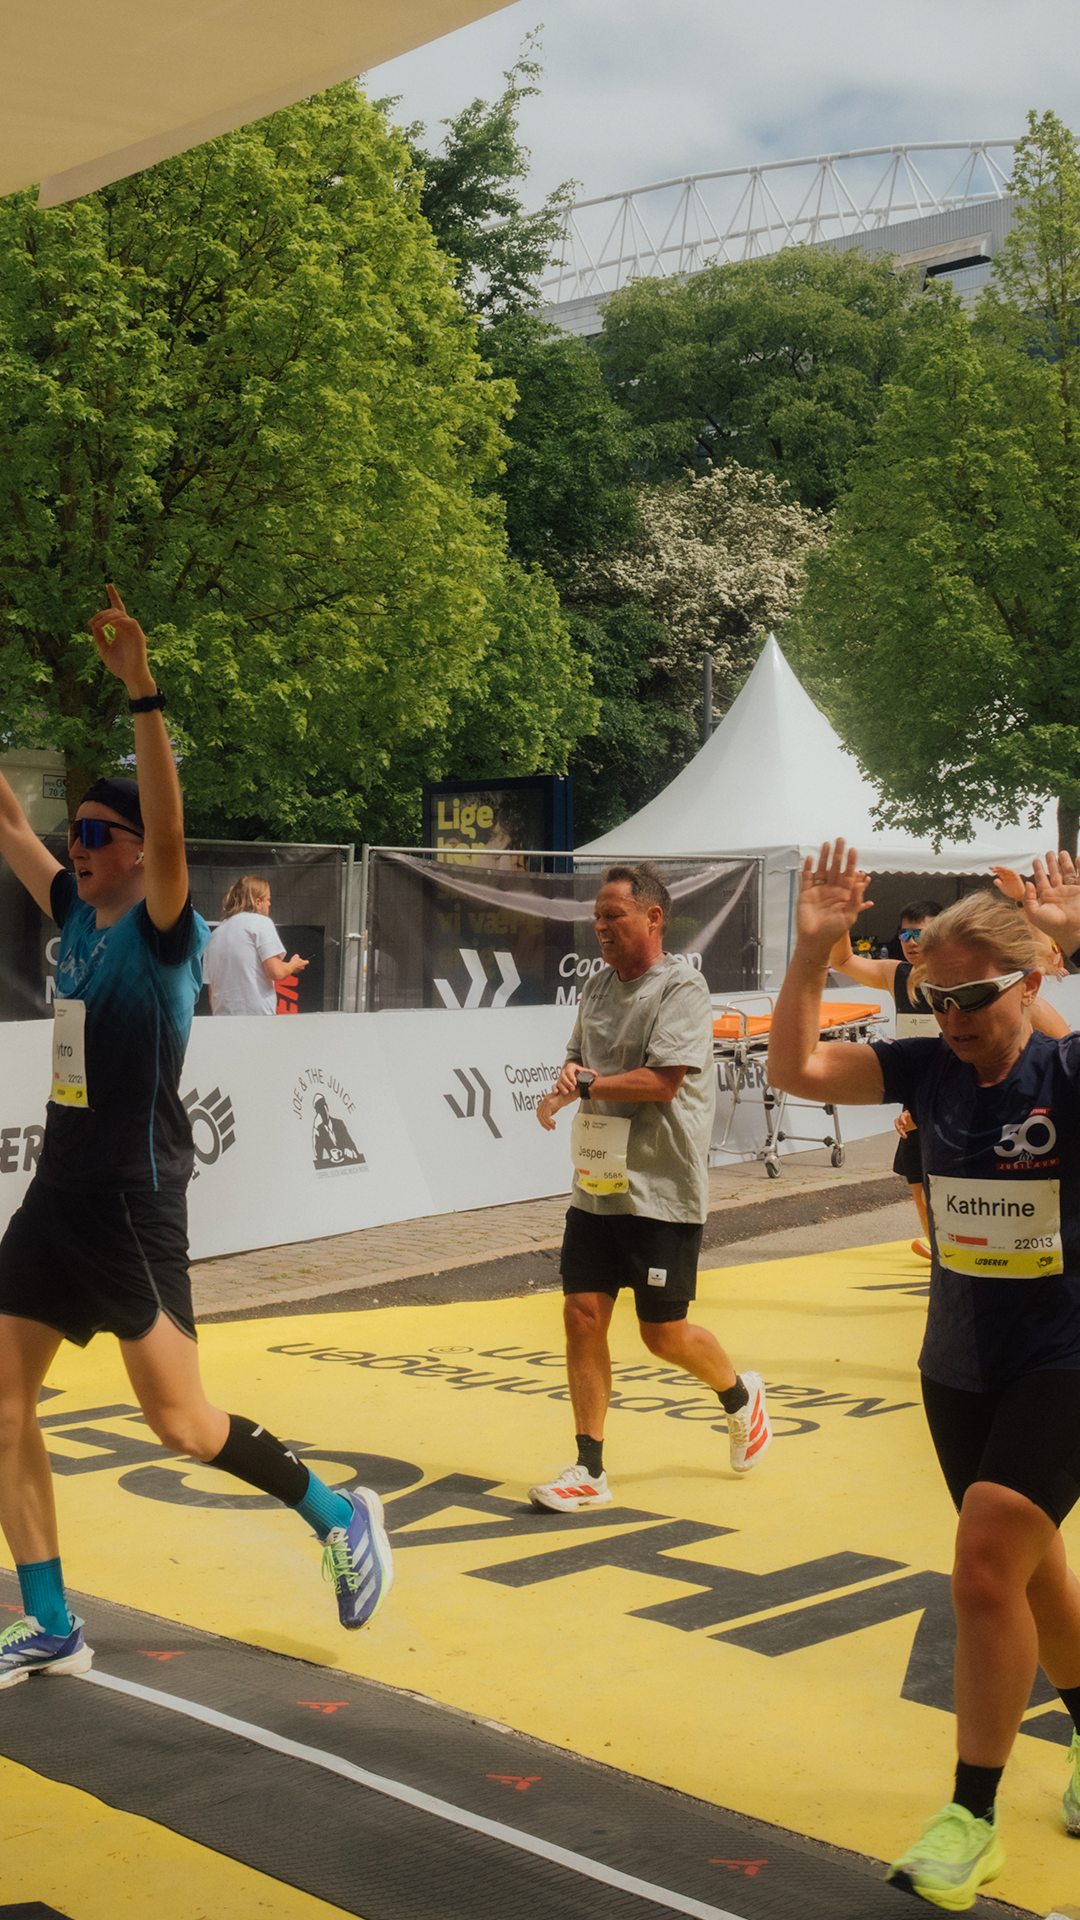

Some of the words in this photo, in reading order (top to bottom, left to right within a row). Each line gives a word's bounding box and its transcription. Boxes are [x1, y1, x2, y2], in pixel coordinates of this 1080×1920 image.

[437, 798, 494, 839] Lige
[504, 1061, 562, 1088] Copenha
[293, 1088, 303, 1120] JOE
[298, 1076, 308, 1092] &
[305, 1068, 324, 1084] THE
[327, 1075, 356, 1114] JUICE
[993, 1114, 1057, 1158] 50
[578, 1144, 608, 1160] Jesper
[946, 1193, 1036, 1218] Kathrine
[1014, 1237, 1054, 1250] 22013
